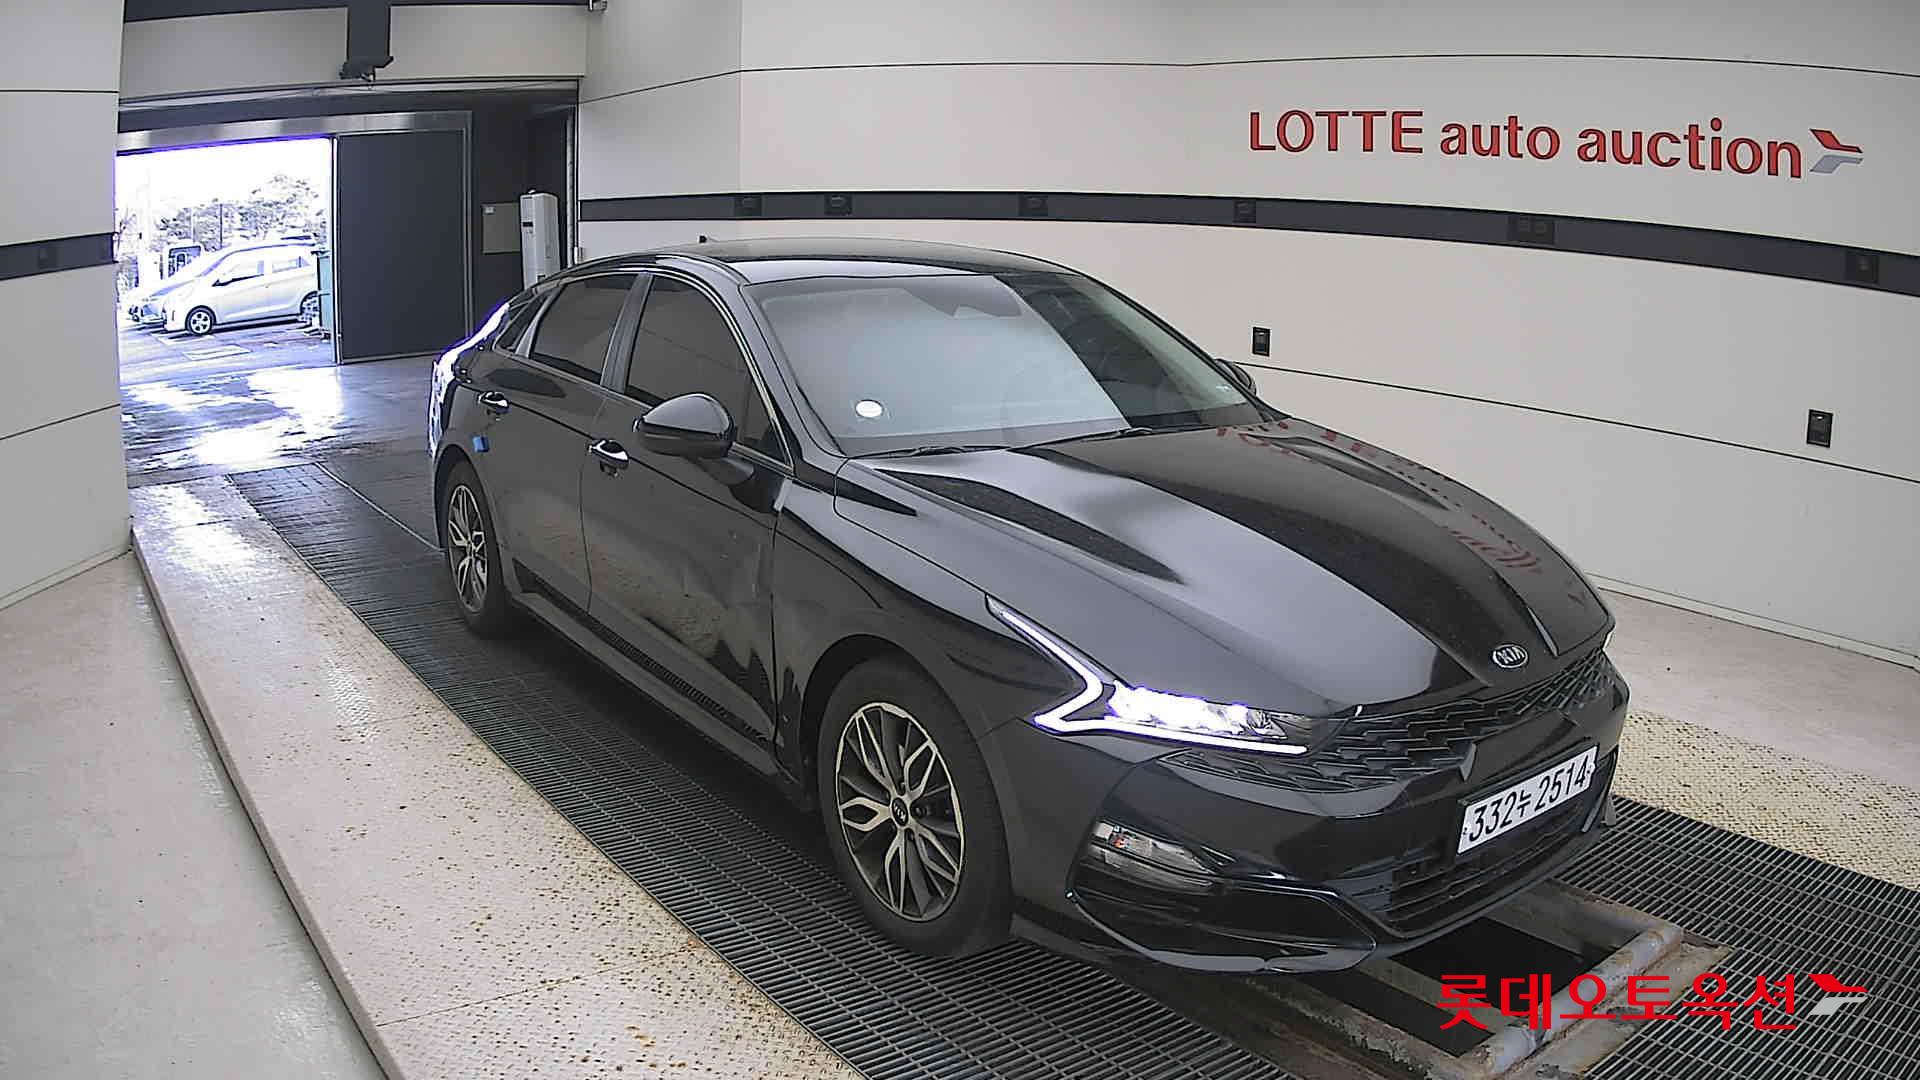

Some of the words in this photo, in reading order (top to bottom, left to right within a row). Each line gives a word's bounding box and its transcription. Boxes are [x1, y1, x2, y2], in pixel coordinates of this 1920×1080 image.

[1248, 110, 1424, 155] LOTTE
[1440, 115, 1562, 161] auto
[1576, 117, 1803, 179] auction
[1496, 646, 1526, 665] KIA
